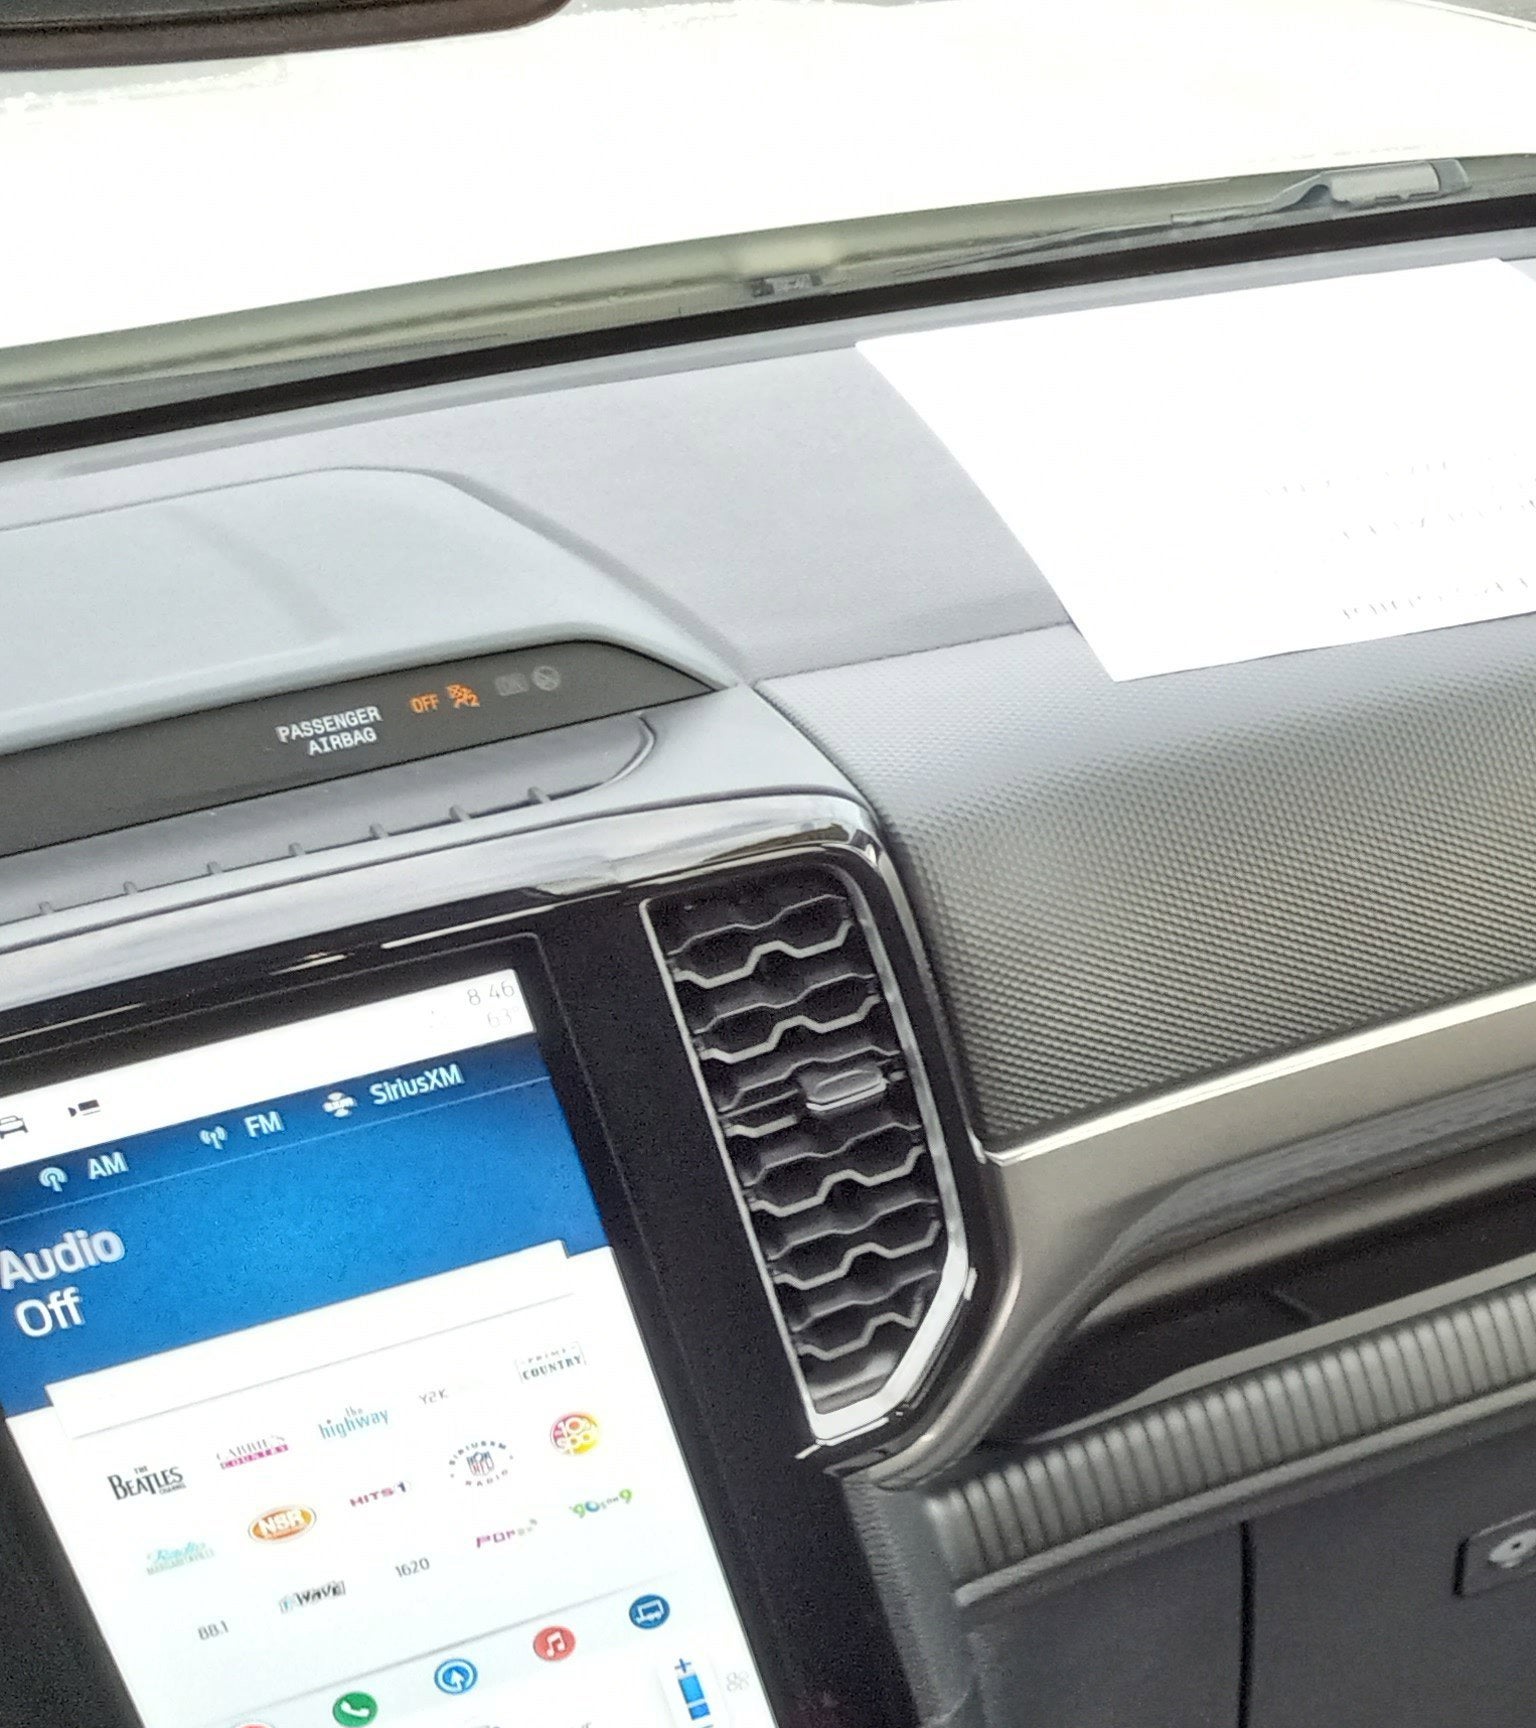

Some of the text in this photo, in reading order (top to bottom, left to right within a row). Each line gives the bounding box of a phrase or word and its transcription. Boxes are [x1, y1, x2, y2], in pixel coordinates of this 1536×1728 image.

[410, 692, 438, 714] OFF
[276, 705, 382, 744] PASSENGER
[308, 727, 378, 756] AIRBAG
[369, 1063, 466, 1105] SiriusXM
[244, 1111, 285, 1138] FM
[88, 1151, 129, 1180] AM
[0, 1229, 126, 1290] Audio
[14, 1286, 85, 1337] Off
[522, 1355, 583, 1381] COUNTRY
[319, 1409, 390, 1440] highway
[108, 1466, 184, 1501] BEATLES
[349, 1486, 394, 1507] HITS
[395, 1556, 431, 1579] 1620
[197, 1619, 230, 1642] 88.1
